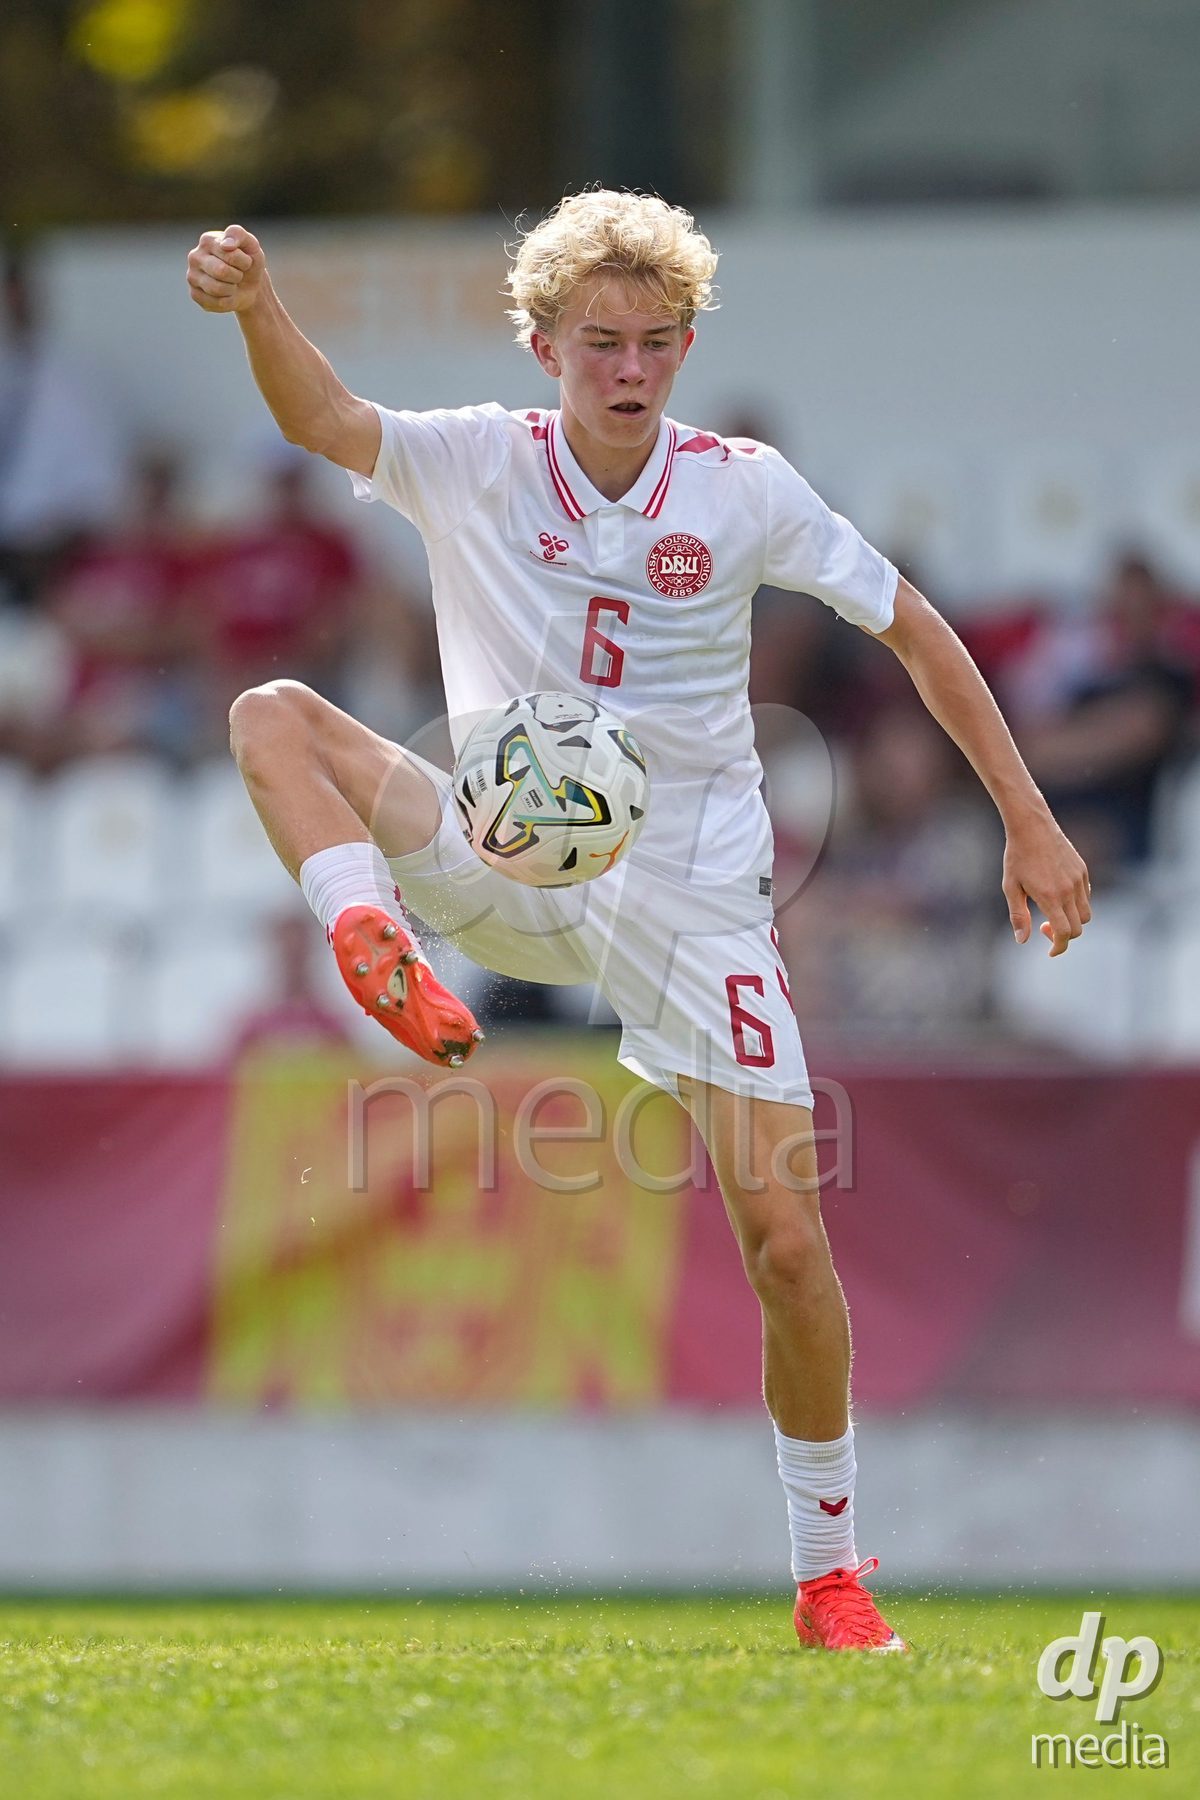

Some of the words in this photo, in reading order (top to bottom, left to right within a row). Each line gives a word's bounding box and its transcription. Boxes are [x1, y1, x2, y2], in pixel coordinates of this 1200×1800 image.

[648, 552, 665, 590] DANSK
[660, 555, 699, 575] DBU
[666, 587, 693, 597] 1889
[579, 596, 630, 688] 6
[725, 974, 776, 1068] 6
